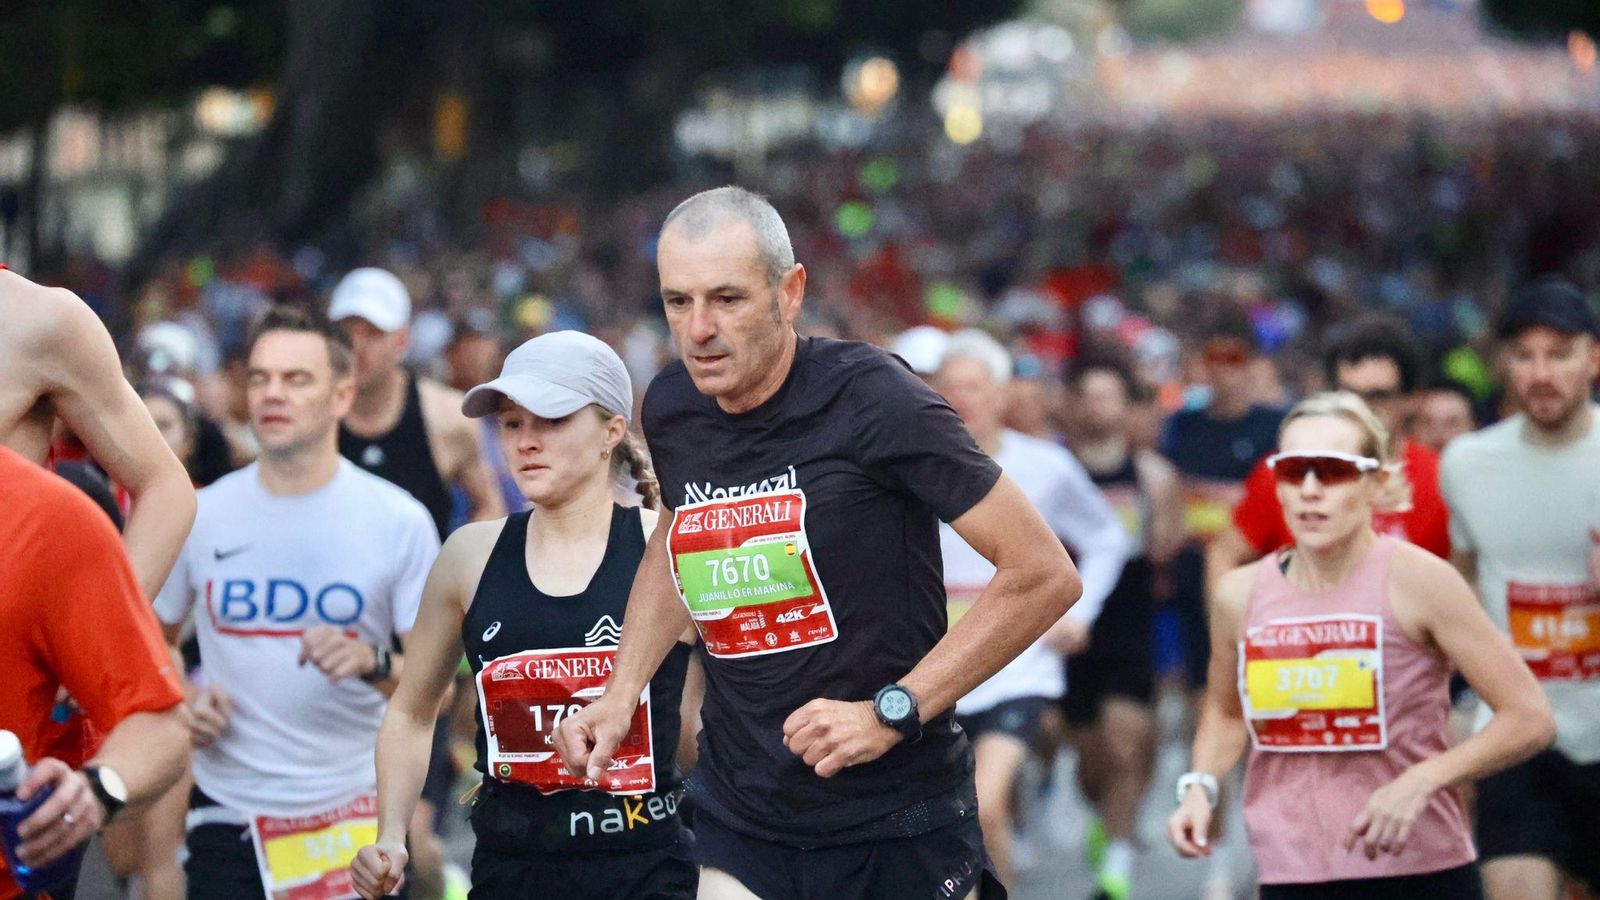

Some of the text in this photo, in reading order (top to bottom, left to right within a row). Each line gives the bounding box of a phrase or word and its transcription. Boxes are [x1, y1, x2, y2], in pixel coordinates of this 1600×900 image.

[704, 501, 792, 531] GENERALI
[705, 553, 771, 587] 7670
[221, 579, 364, 625] BDO
[699, 581, 795, 603] JUANILLO ER MAKINA
[776, 609, 804, 624] 42K
[525, 657, 614, 680] GENERA
[1276, 664, 1339, 692] 3707
[529, 704, 583, 732] 17
